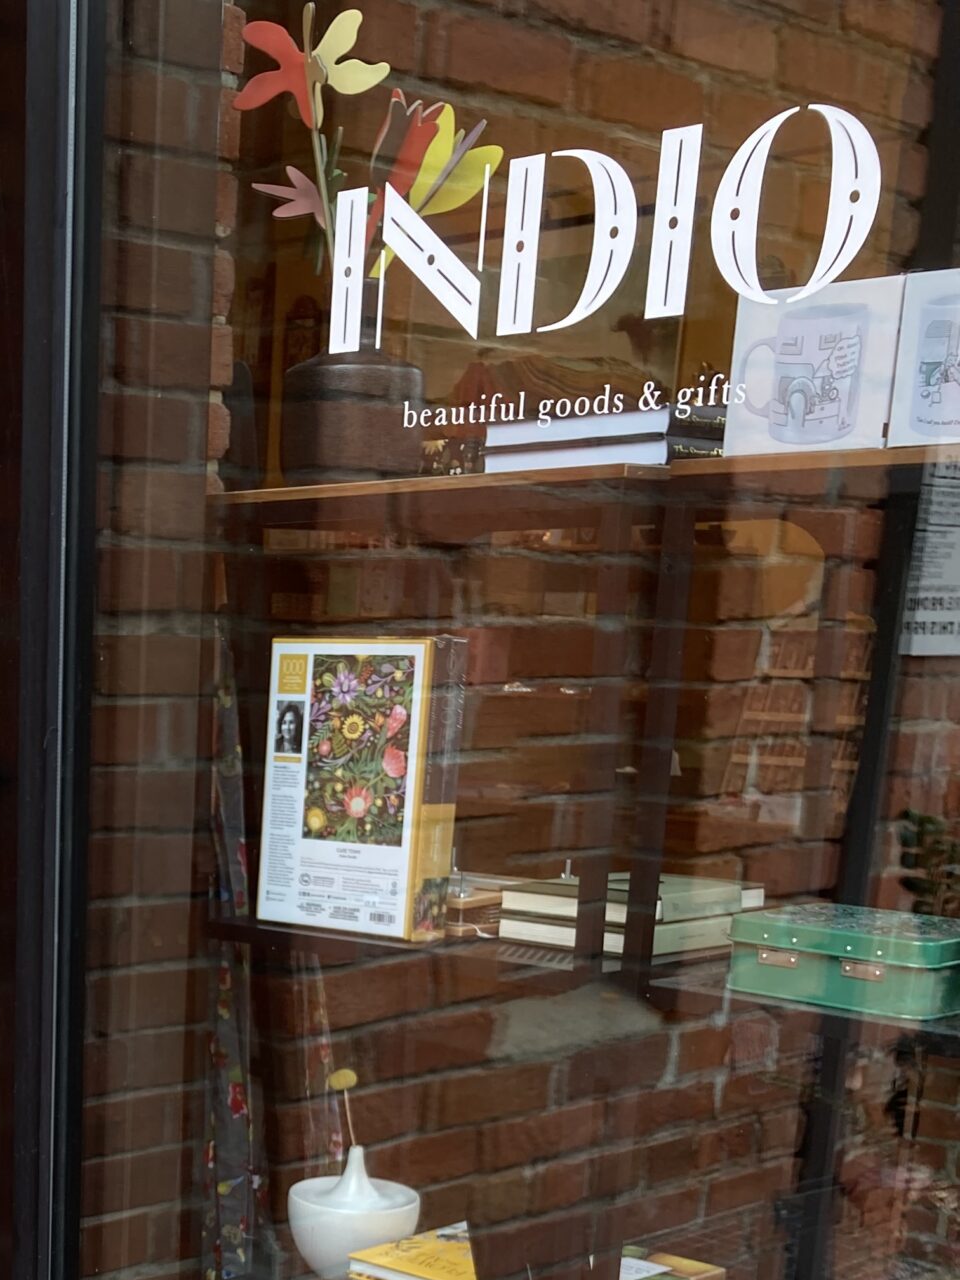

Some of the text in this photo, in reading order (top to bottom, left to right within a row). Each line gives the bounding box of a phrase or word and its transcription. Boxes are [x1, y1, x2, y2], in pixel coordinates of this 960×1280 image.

[328, 104, 882, 354] INDIO
[403, 373, 746, 428] beautiful goods & gifts
